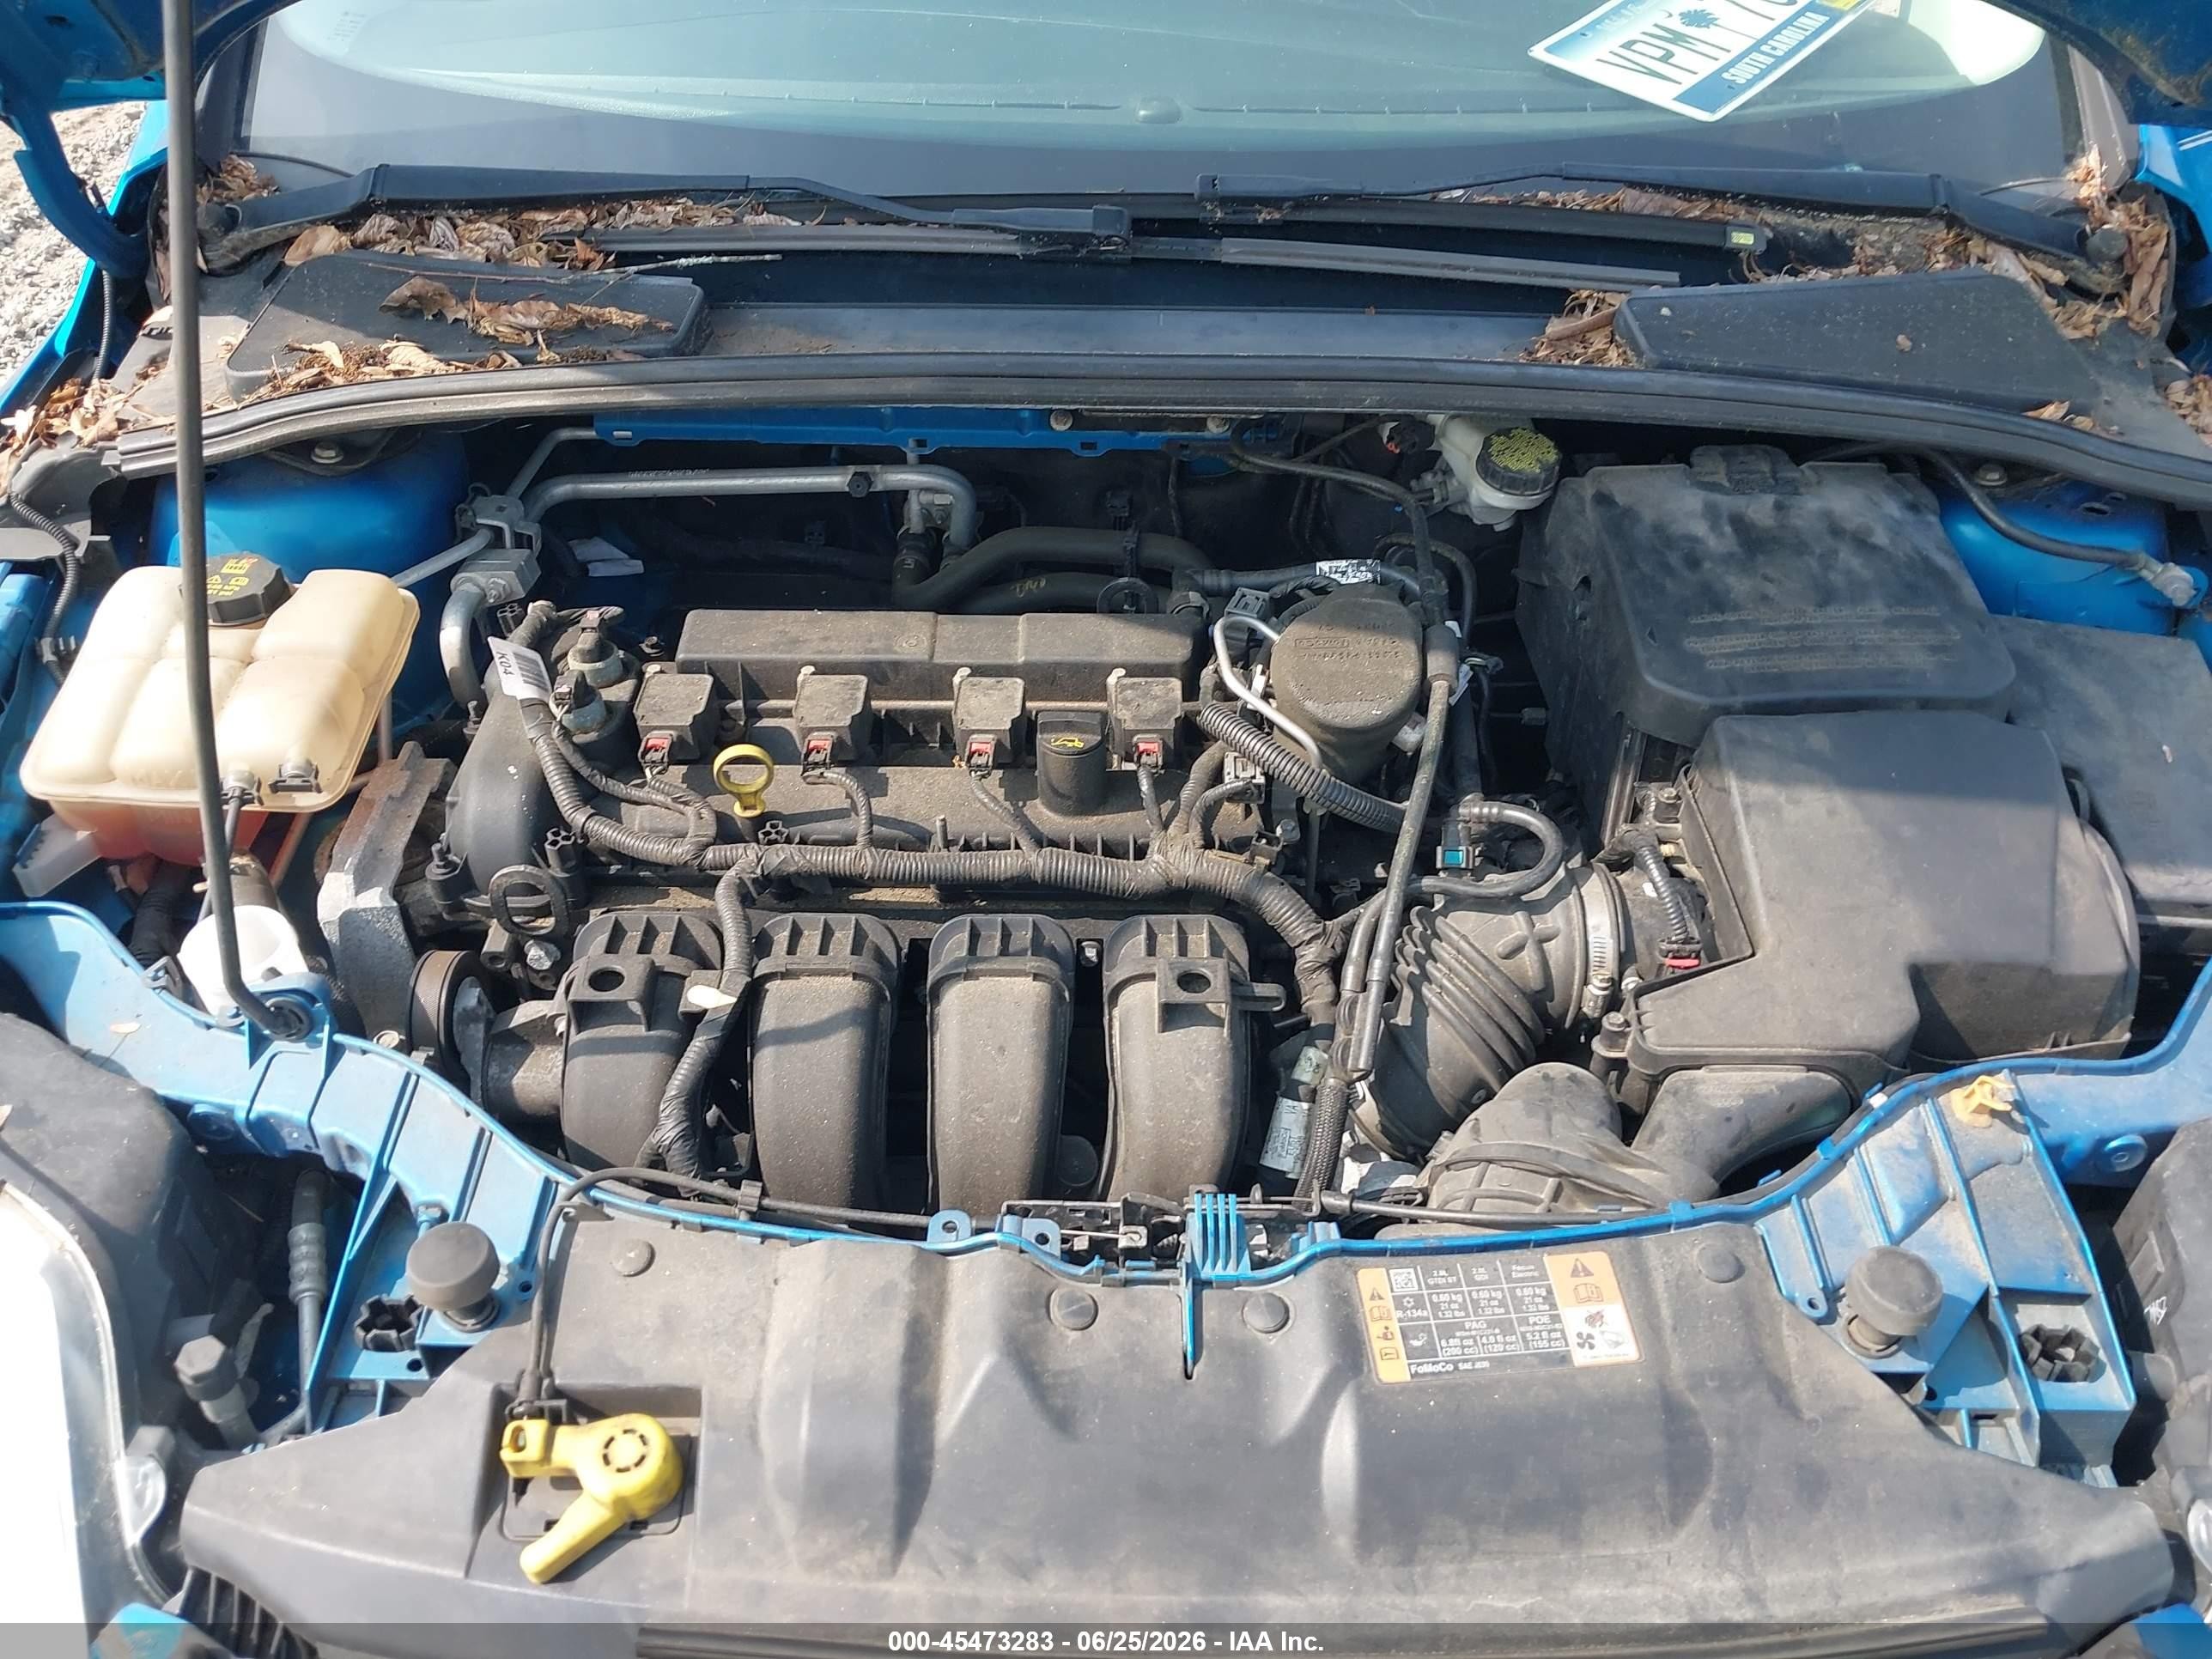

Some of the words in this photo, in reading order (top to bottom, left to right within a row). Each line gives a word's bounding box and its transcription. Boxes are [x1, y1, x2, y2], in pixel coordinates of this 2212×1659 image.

[1721, 52, 1777, 84] SOUTH
[1759, 11, 1831, 56] CAROLINA
[1596, 23, 1731, 85] VPM
[1491, 1290, 1502, 1299] kg
[1534, 1286, 1547, 1297] kg
[1450, 1293, 1463, 1303] kg
[1396, 1308, 1428, 1319] R-134a
[1528, 1315, 1552, 1324] POE
[1464, 1321, 1487, 1329] PAG
[1505, 1343, 1520, 1352] cc)
[1550, 1339, 1565, 1347] cc)
[1463, 1346, 1478, 1355] cc)
[1410, 1362, 1454, 1374] FoMoCo
